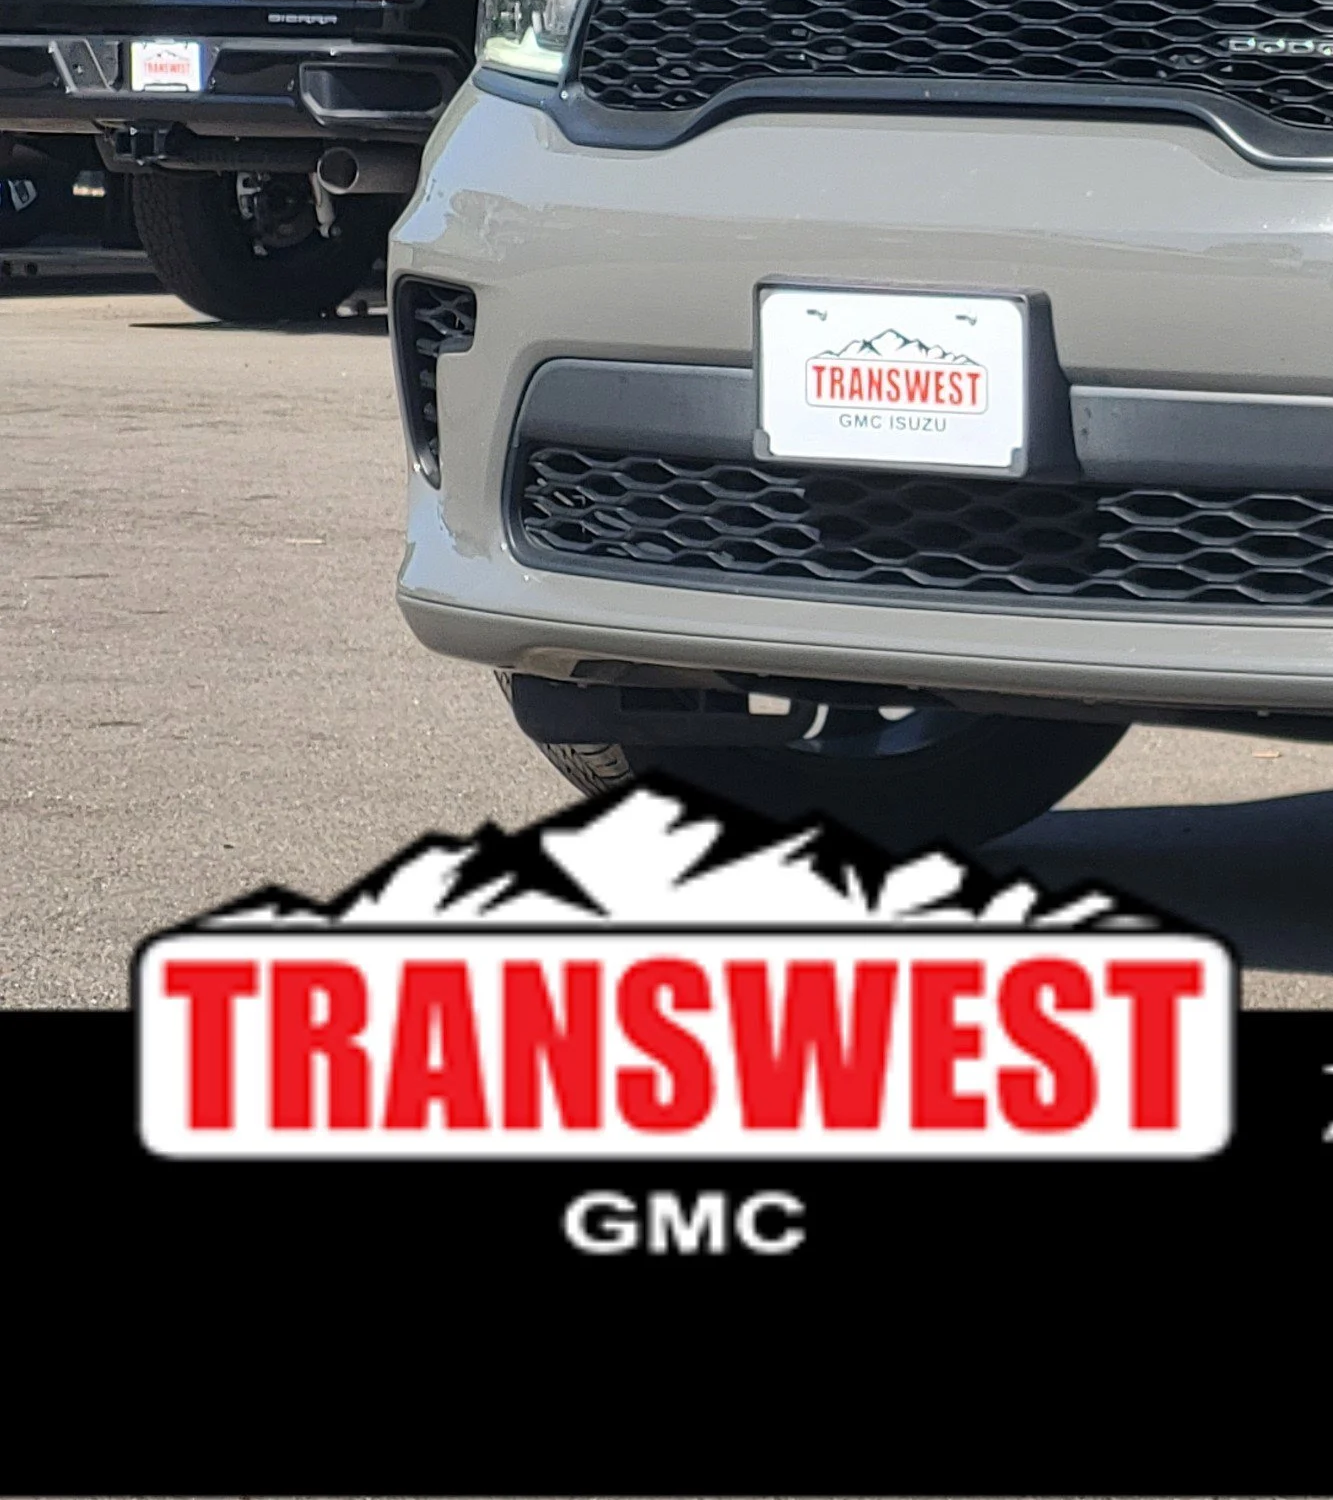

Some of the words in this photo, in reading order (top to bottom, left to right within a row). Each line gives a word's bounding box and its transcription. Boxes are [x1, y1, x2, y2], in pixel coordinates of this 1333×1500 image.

[811, 365, 981, 407] TRANSWEST
[838, 414, 883, 430] GMC
[889, 416, 948, 432] ISUZU
